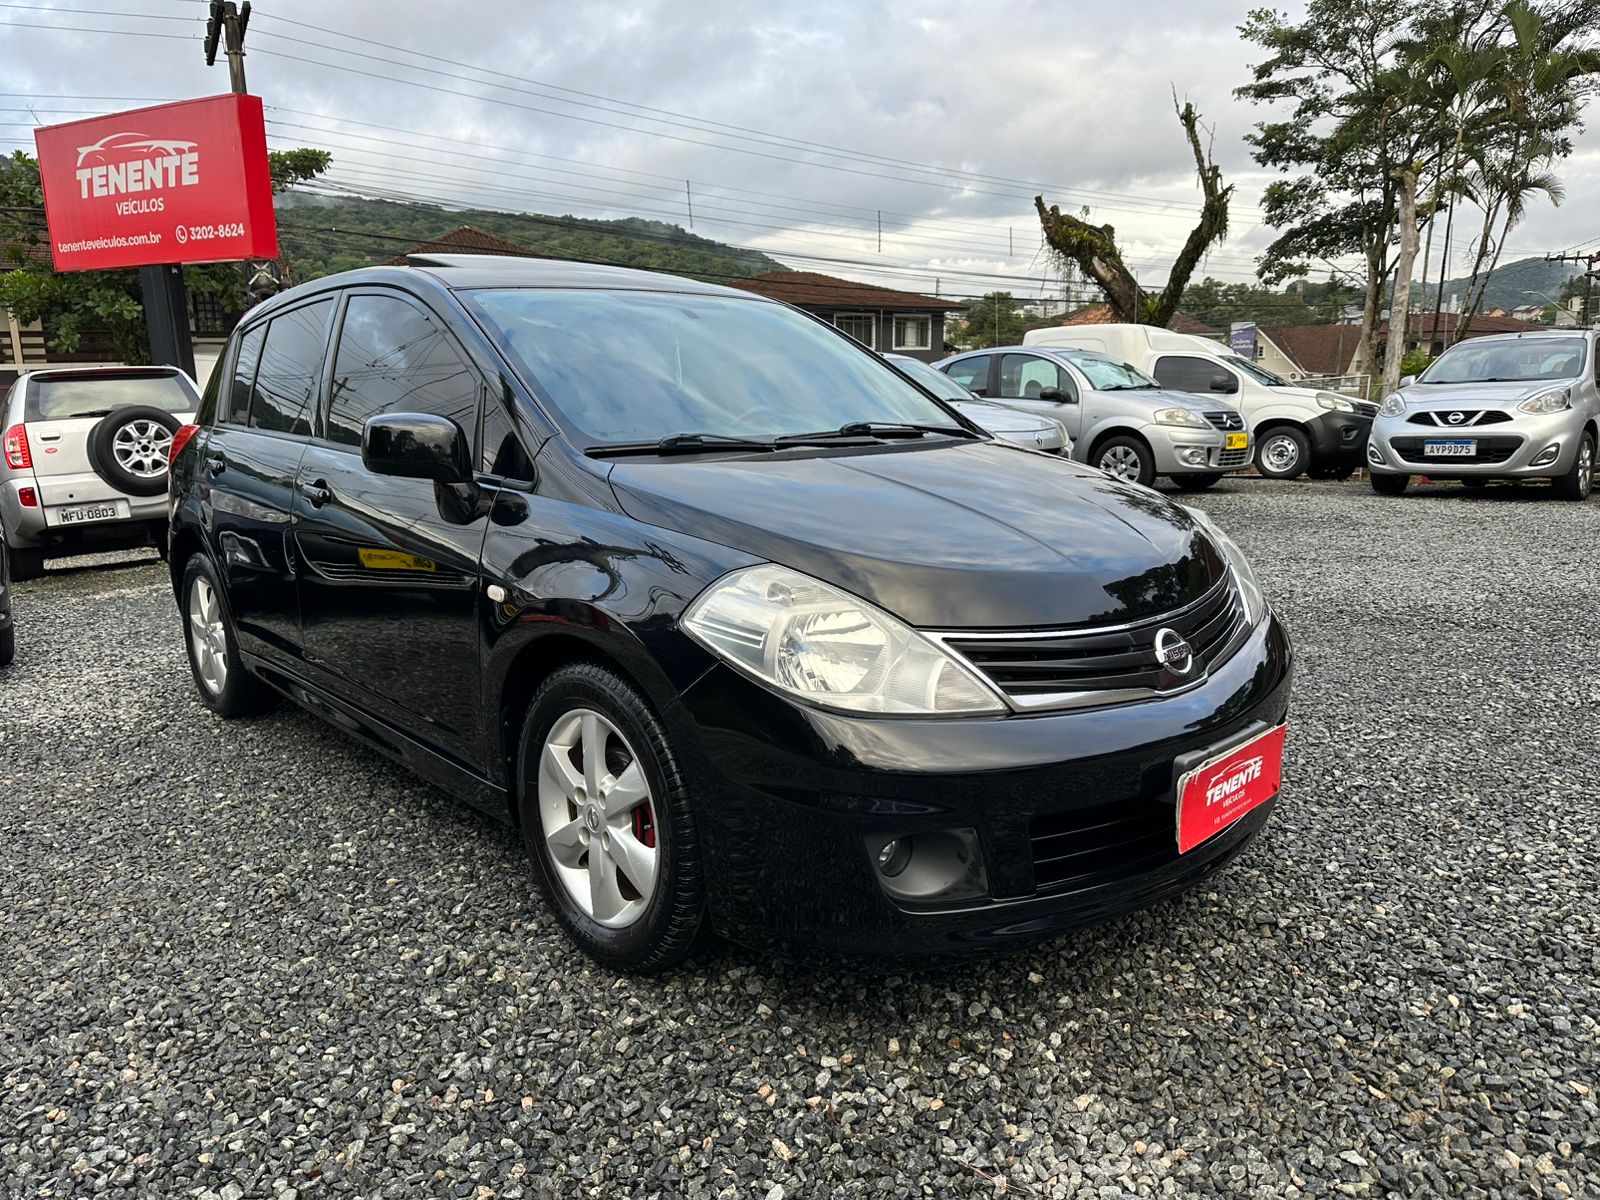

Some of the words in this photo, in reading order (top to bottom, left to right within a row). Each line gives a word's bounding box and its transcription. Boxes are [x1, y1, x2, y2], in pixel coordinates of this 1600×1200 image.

[76, 152, 199, 199] TENENTE
[116, 197, 164, 216] VEÍCULOS
[189, 223, 244, 240] 3202-8624
[58, 232, 162, 253] tenenteveiculos.com.br
[1430, 446, 1471, 454] AYP9D75
[1205, 760, 1263, 807] TENENTE
